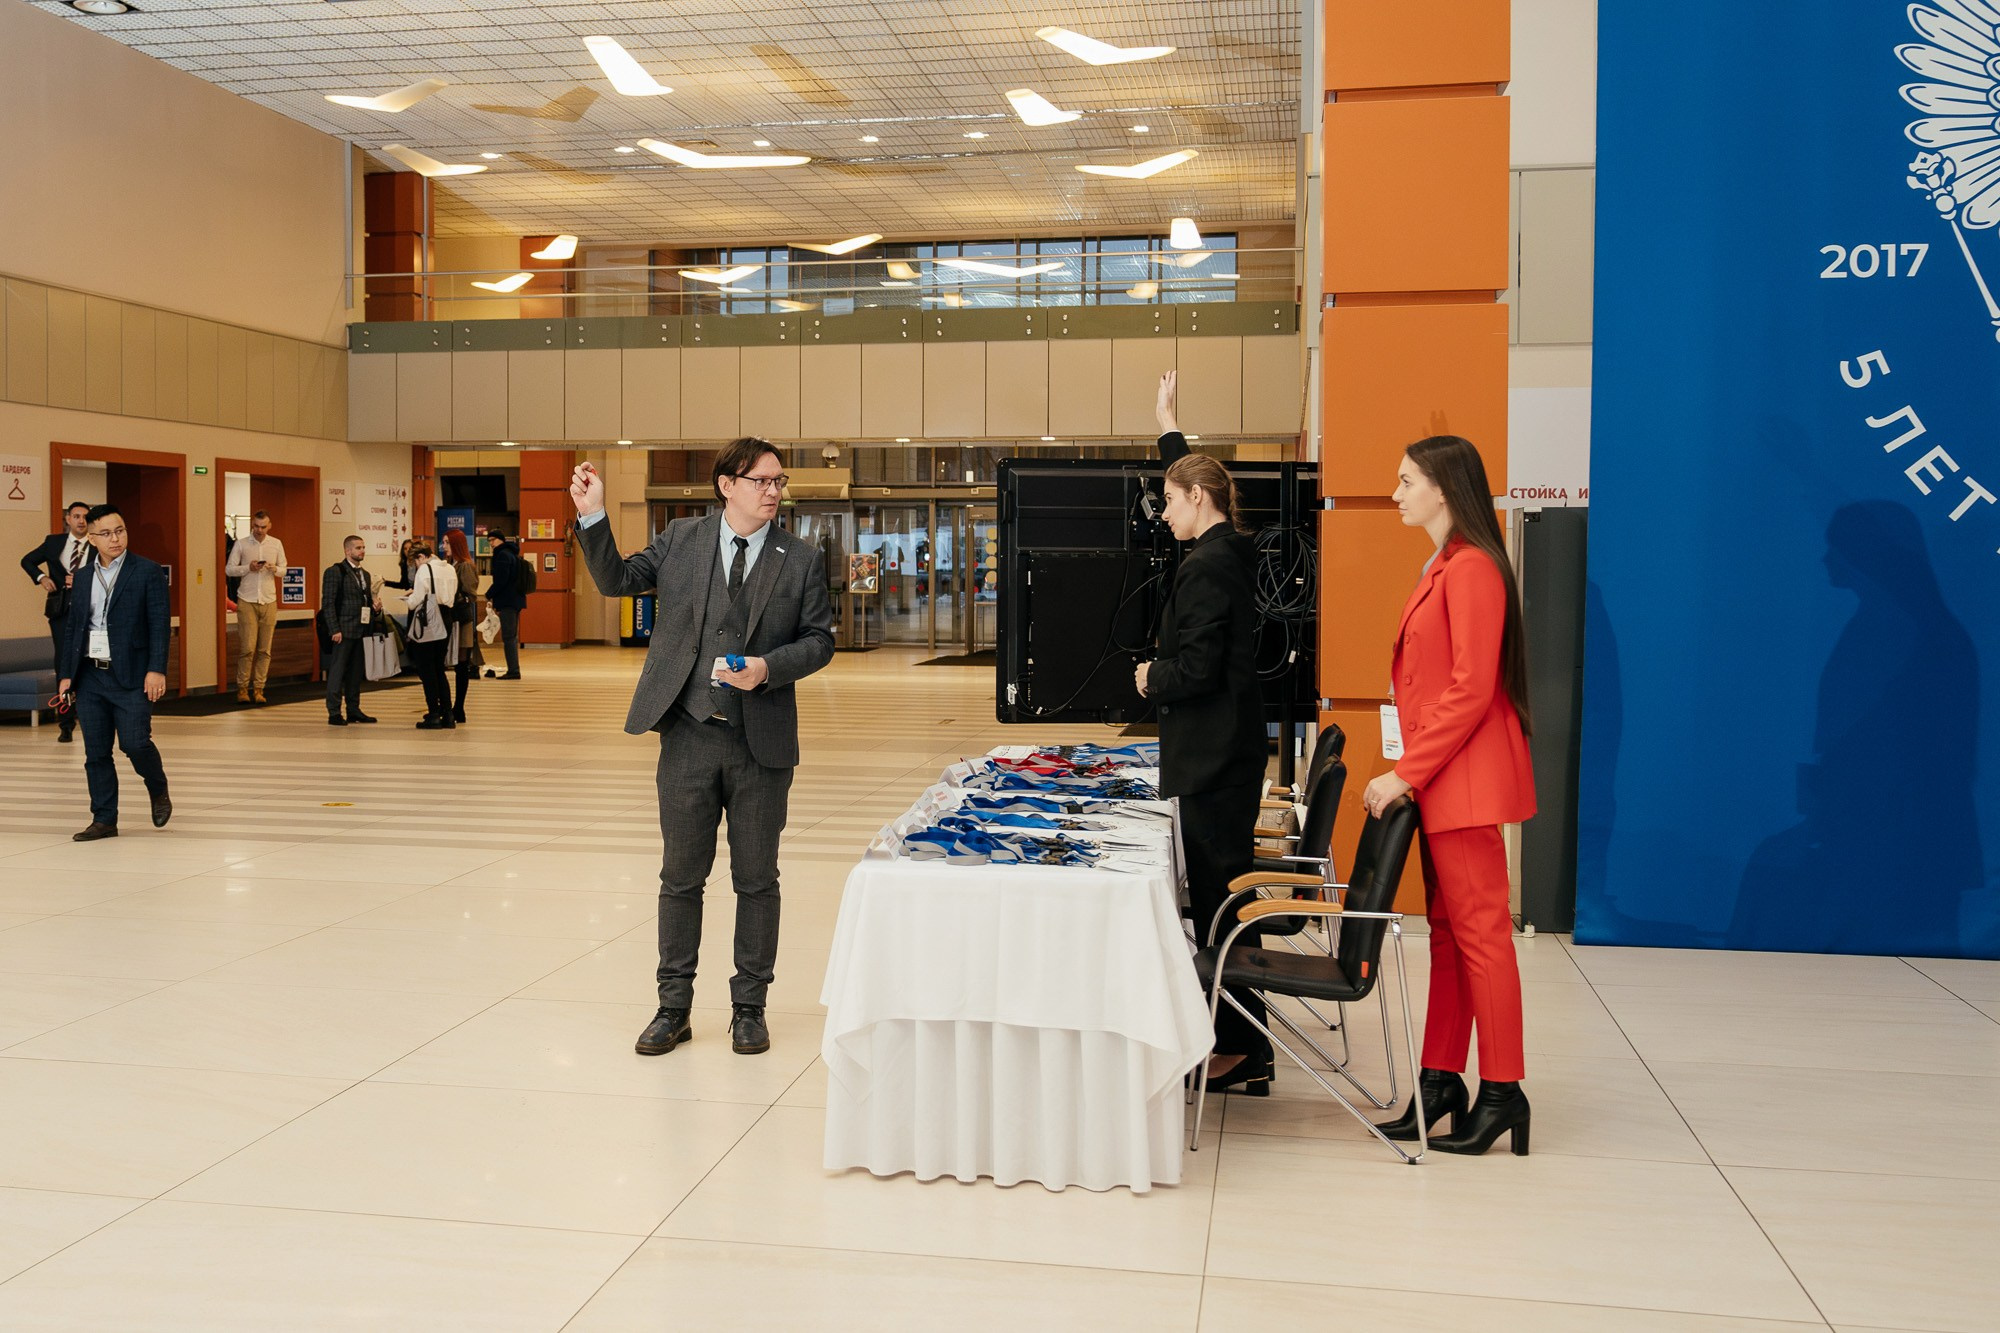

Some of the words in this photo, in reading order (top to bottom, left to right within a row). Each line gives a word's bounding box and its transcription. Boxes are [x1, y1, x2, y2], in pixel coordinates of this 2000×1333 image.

[1819, 243, 1929, 279] 2017
[1839, 349, 1891, 389] 5
[2, 464, 31, 475] ГАРДЕРОБ
[1864, 404, 1998, 522] ЛЕТ
[1509, 484, 1568, 499] СТОЙКА
